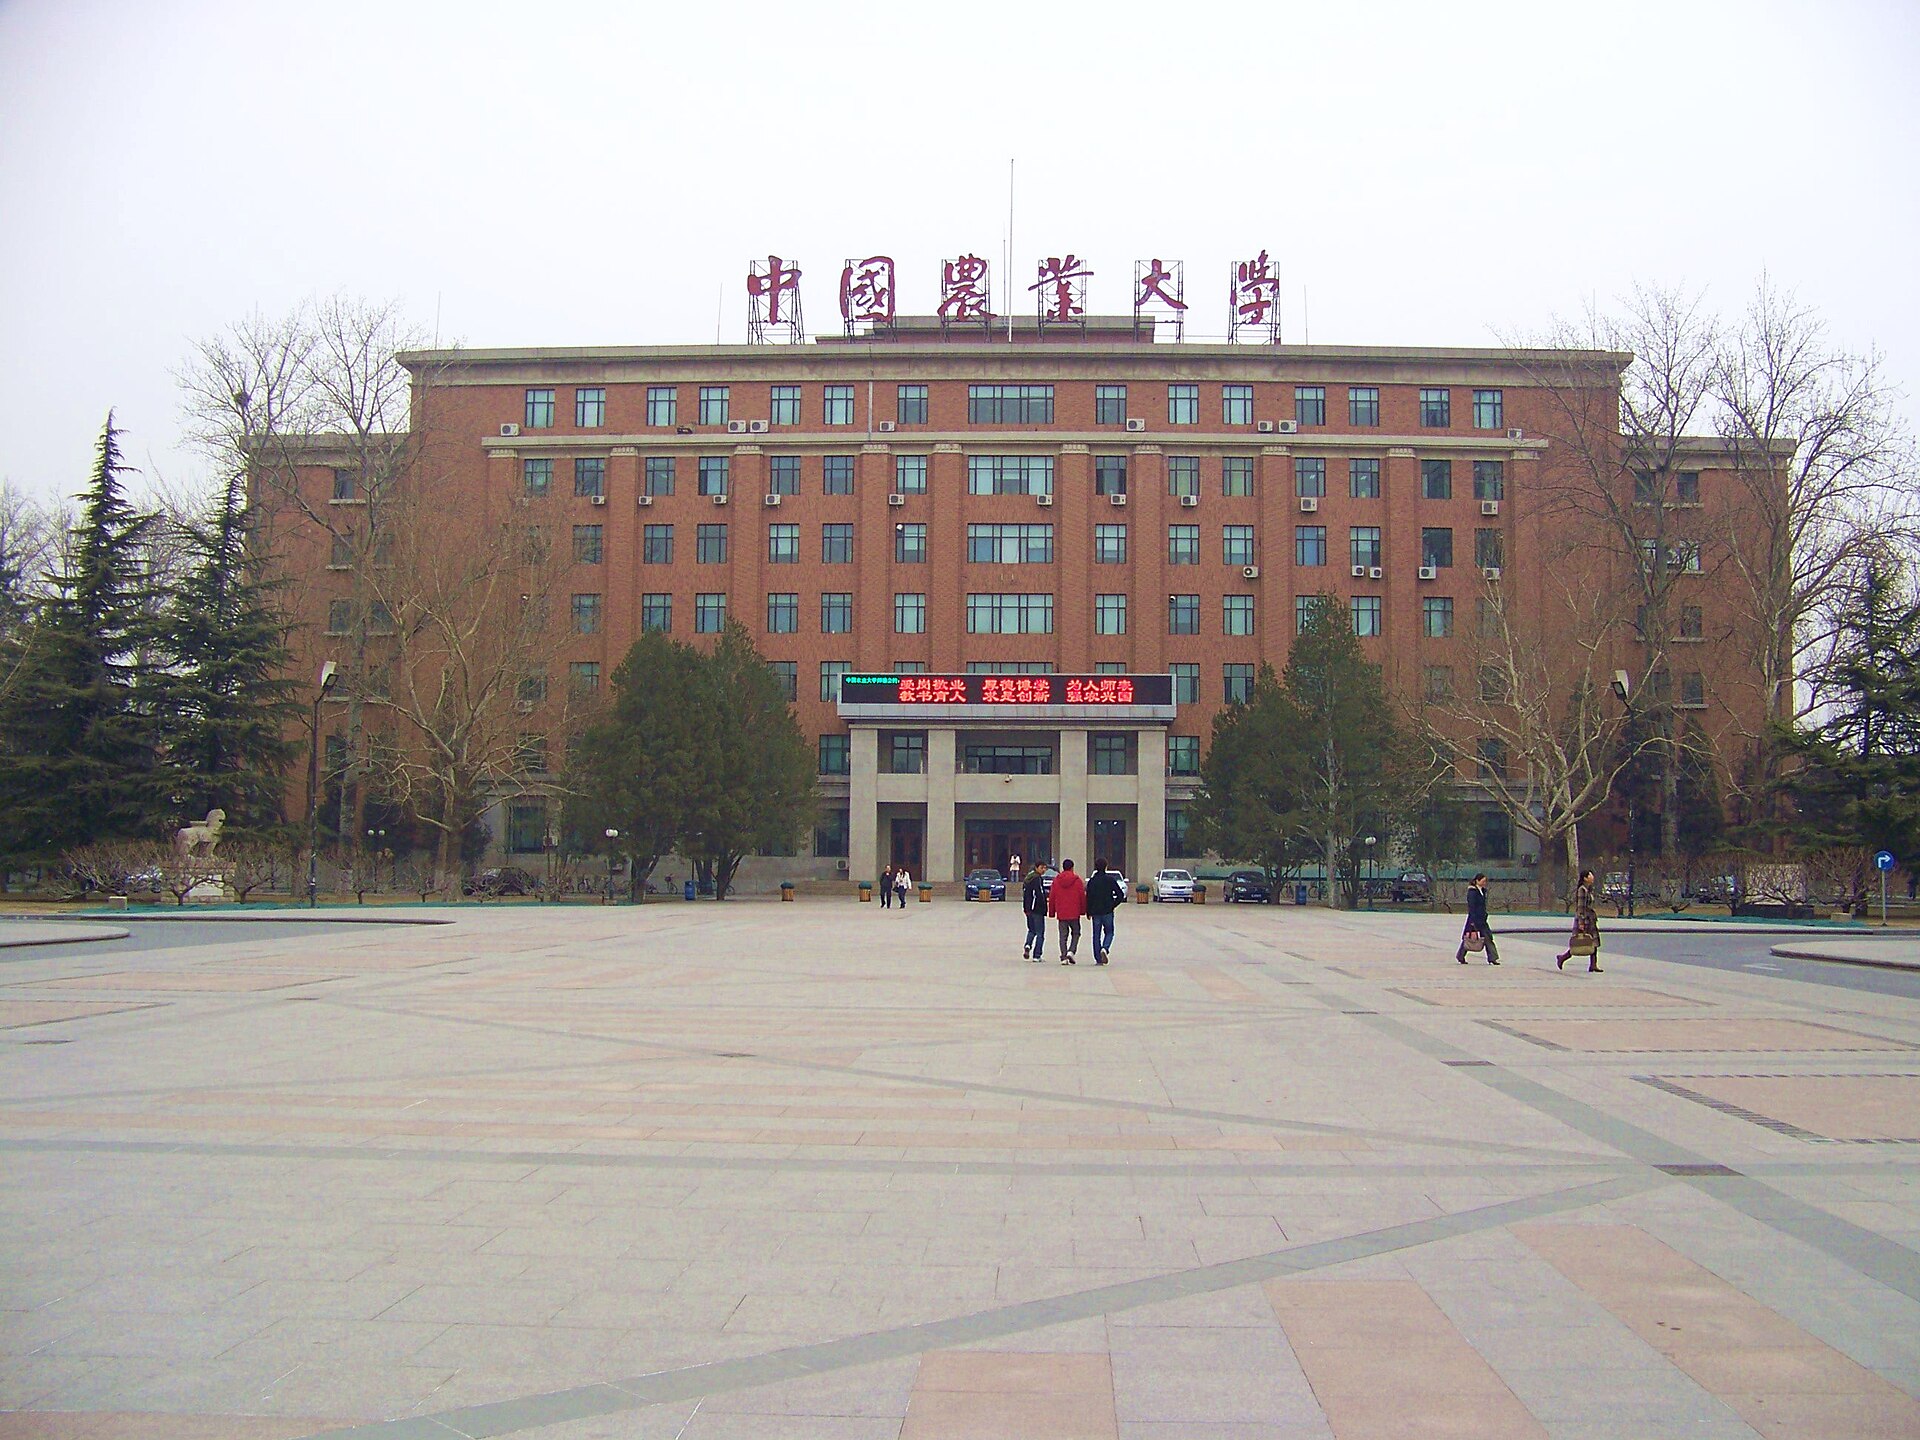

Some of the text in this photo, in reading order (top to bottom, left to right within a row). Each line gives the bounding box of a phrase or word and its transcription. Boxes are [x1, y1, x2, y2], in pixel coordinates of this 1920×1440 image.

[899, 678, 1133, 690] 爱岗敬业 厚德博学 为人师表
[899, 691, 1133, 702] 教书育人 求是创新 强农兴国
